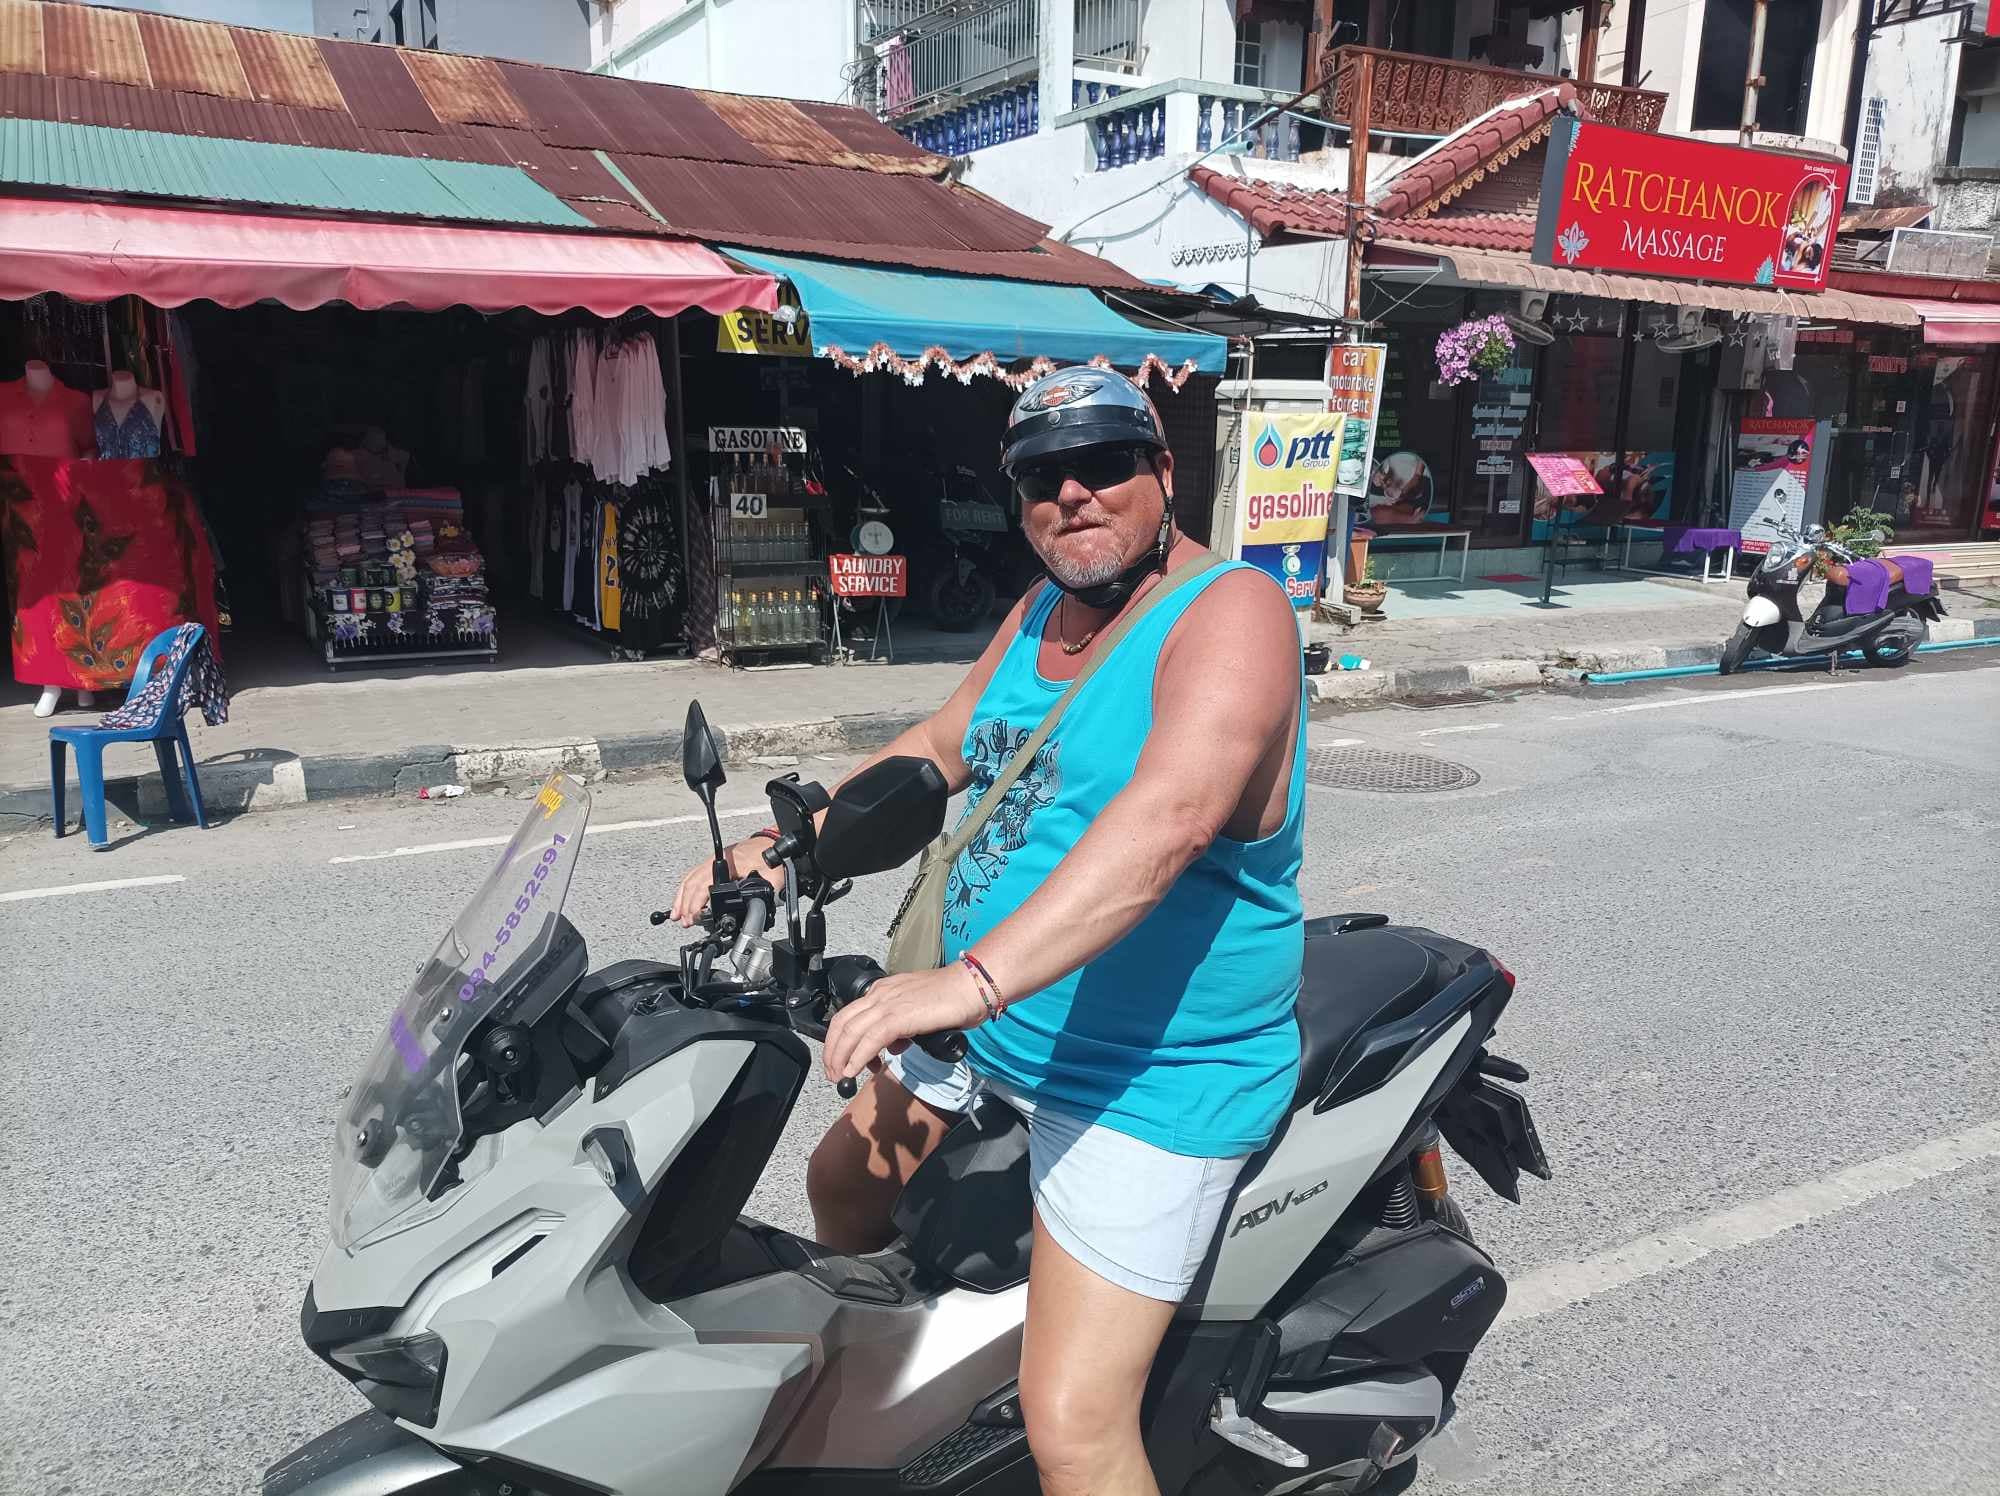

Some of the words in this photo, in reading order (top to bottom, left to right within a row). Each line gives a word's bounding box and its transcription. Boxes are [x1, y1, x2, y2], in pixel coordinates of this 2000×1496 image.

[1573, 162, 1783, 229] RATCHANOK
[1622, 220, 1727, 264] MASSAGE
[1342, 351, 1367, 367] car
[714, 429, 803, 449] GASOLINE
[1285, 430, 1335, 469] ptt
[1302, 458, 1330, 469] Group
[736, 496, 763, 516] 40
[832, 557, 903, 575] LAUNDRY
[838, 576, 898, 593] SERVICE
[457, 832, 567, 1002] 094-5852591
